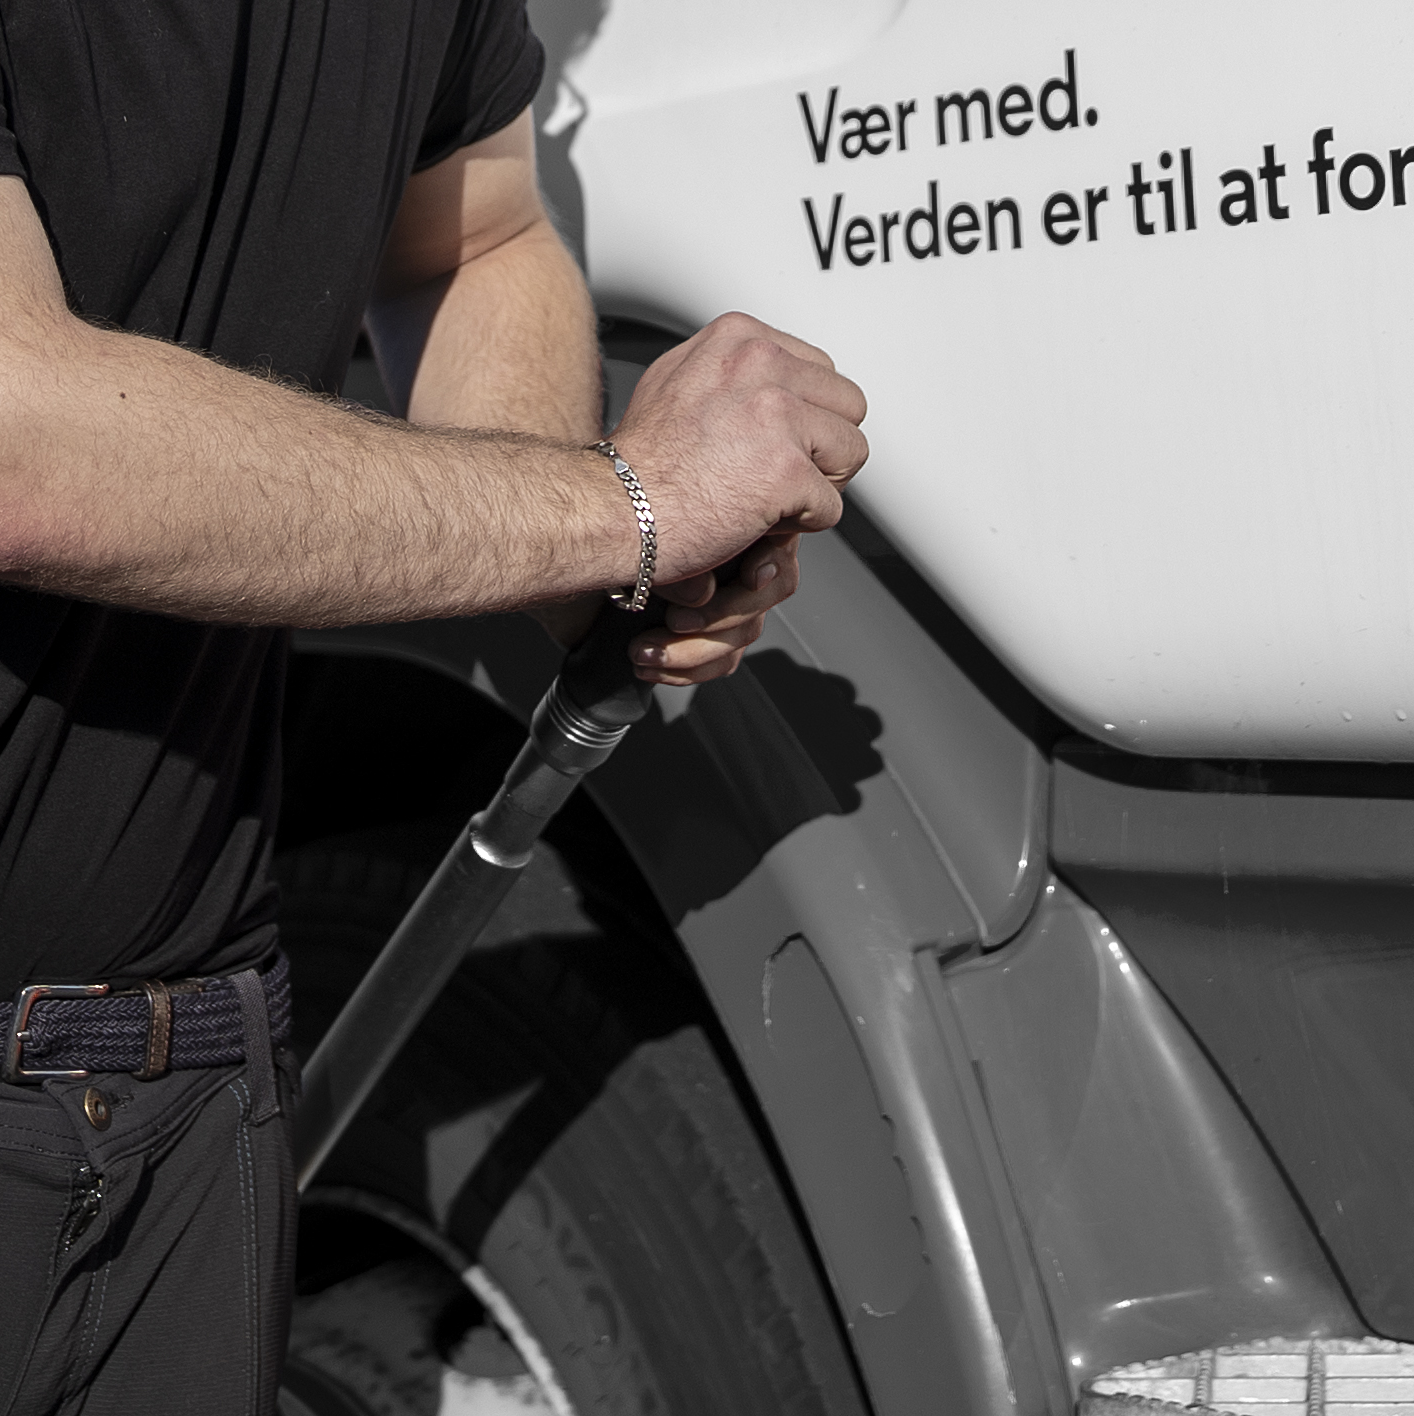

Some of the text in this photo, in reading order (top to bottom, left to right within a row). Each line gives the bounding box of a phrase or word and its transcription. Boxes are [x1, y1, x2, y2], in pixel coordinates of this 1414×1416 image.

[799, 48, 1099, 165] Vær med.
[803, 179, 1023, 271] Verden
[1042, 184, 1110, 247] er
[1126, 148, 1198, 237] til
[1218, 143, 1291, 228] at
